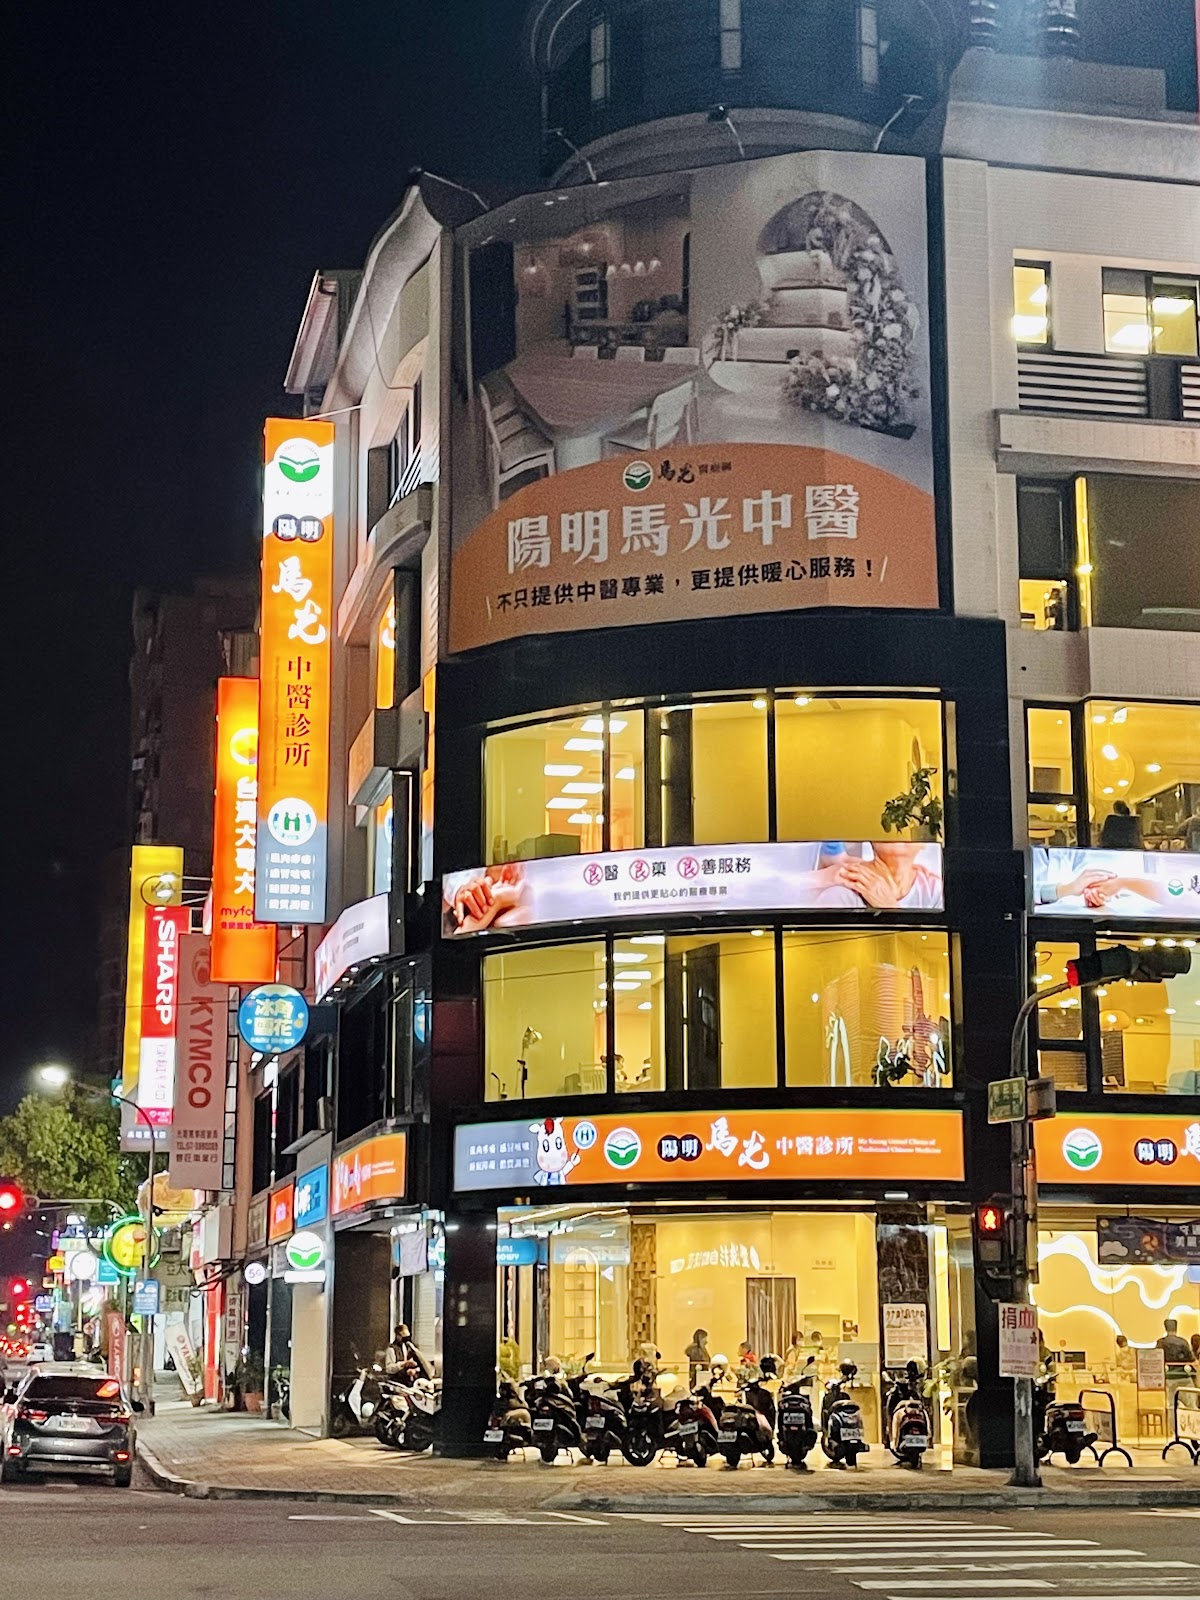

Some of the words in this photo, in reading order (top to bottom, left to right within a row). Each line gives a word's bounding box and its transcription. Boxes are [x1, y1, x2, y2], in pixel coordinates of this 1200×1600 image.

[276, 516, 321, 540] 陽明
[506, 482, 861, 575] 陽明馬光中醫
[495, 558, 876, 612] 不只提供中醫專業，更提供暖心服務！
[284, 655, 312, 768] 中醫診所
[233, 776, 258, 895] 台灣大哥大
[220, 907, 254, 918] myfo
[156, 919, 176, 1025] SHARP
[188, 996, 213, 1109] KYMCO
[661, 1138, 698, 1158] 陽明
[775, 1135, 853, 1156] 中醫診所
[1137, 1142, 1173, 1162] 陽明
[249, 1269, 263, 1279] 5G
[1002, 1307, 1035, 1330] 捐血
